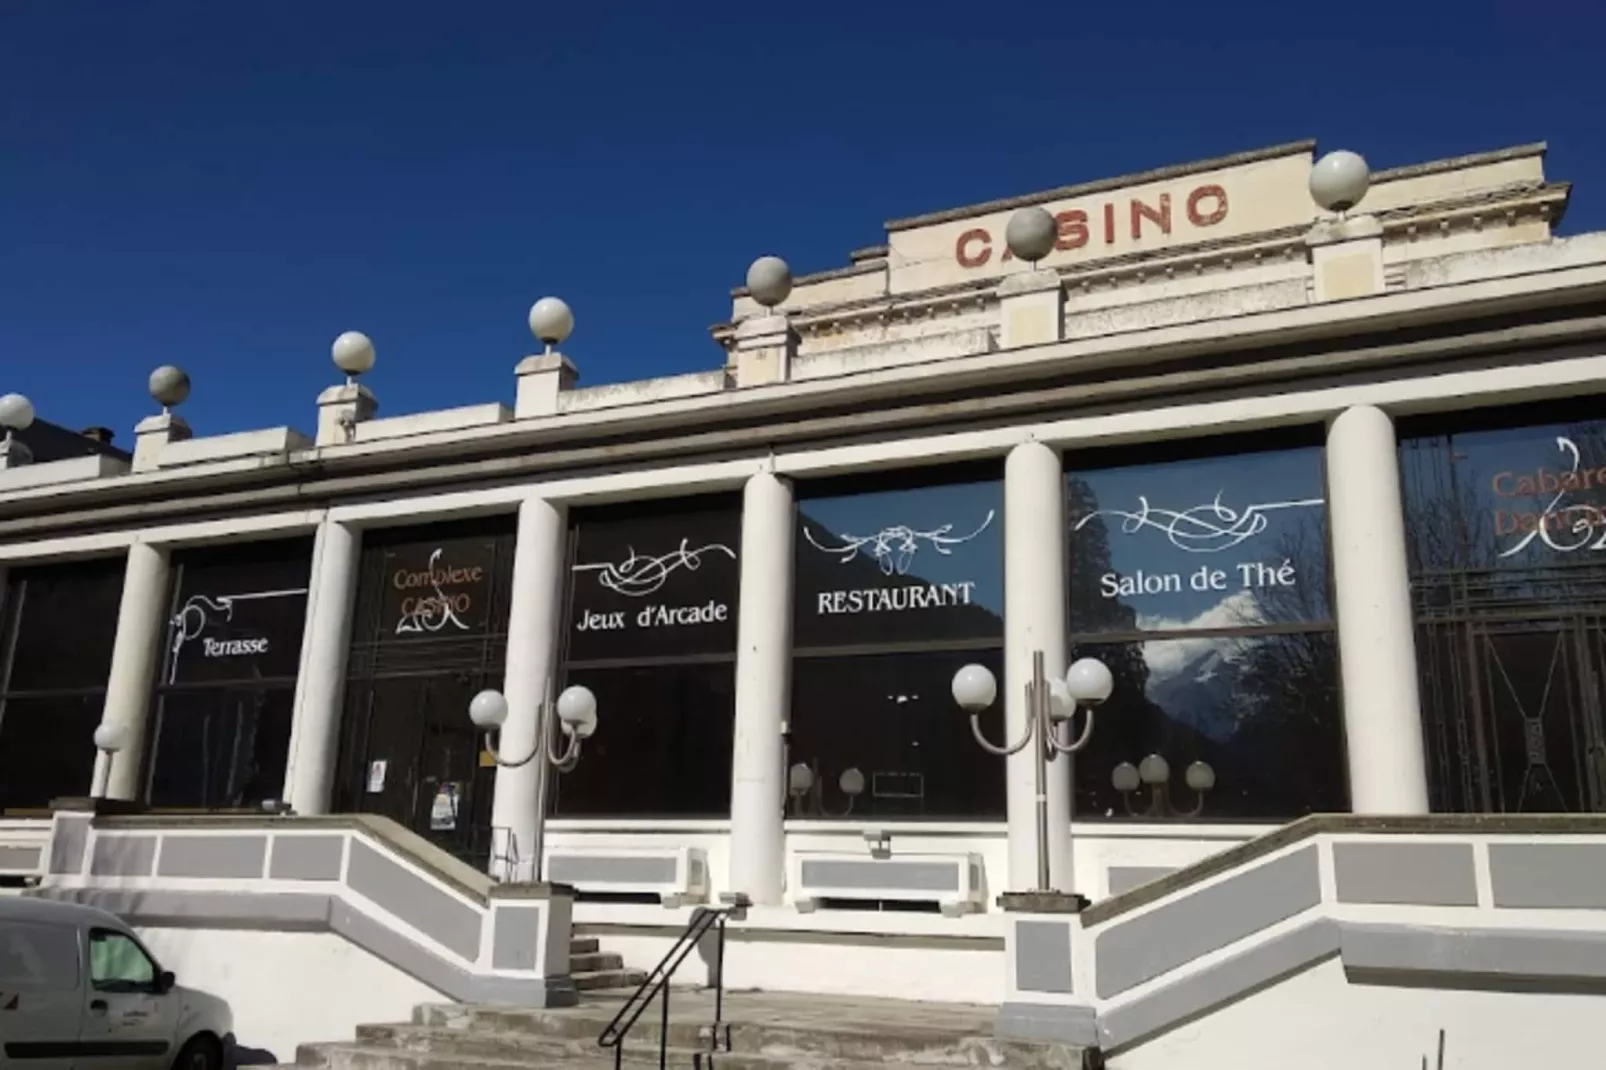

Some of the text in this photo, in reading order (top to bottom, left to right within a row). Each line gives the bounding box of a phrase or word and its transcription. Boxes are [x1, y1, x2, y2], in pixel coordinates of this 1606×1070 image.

[955, 184, 1228, 268] CSINO
[1100, 558, 1296, 598] Salon de Thé
[817, 581, 976, 614] RESTAURANT
[576, 600, 728, 631] Jeux d'Arcade
[203, 637, 269, 657] Terrasse
